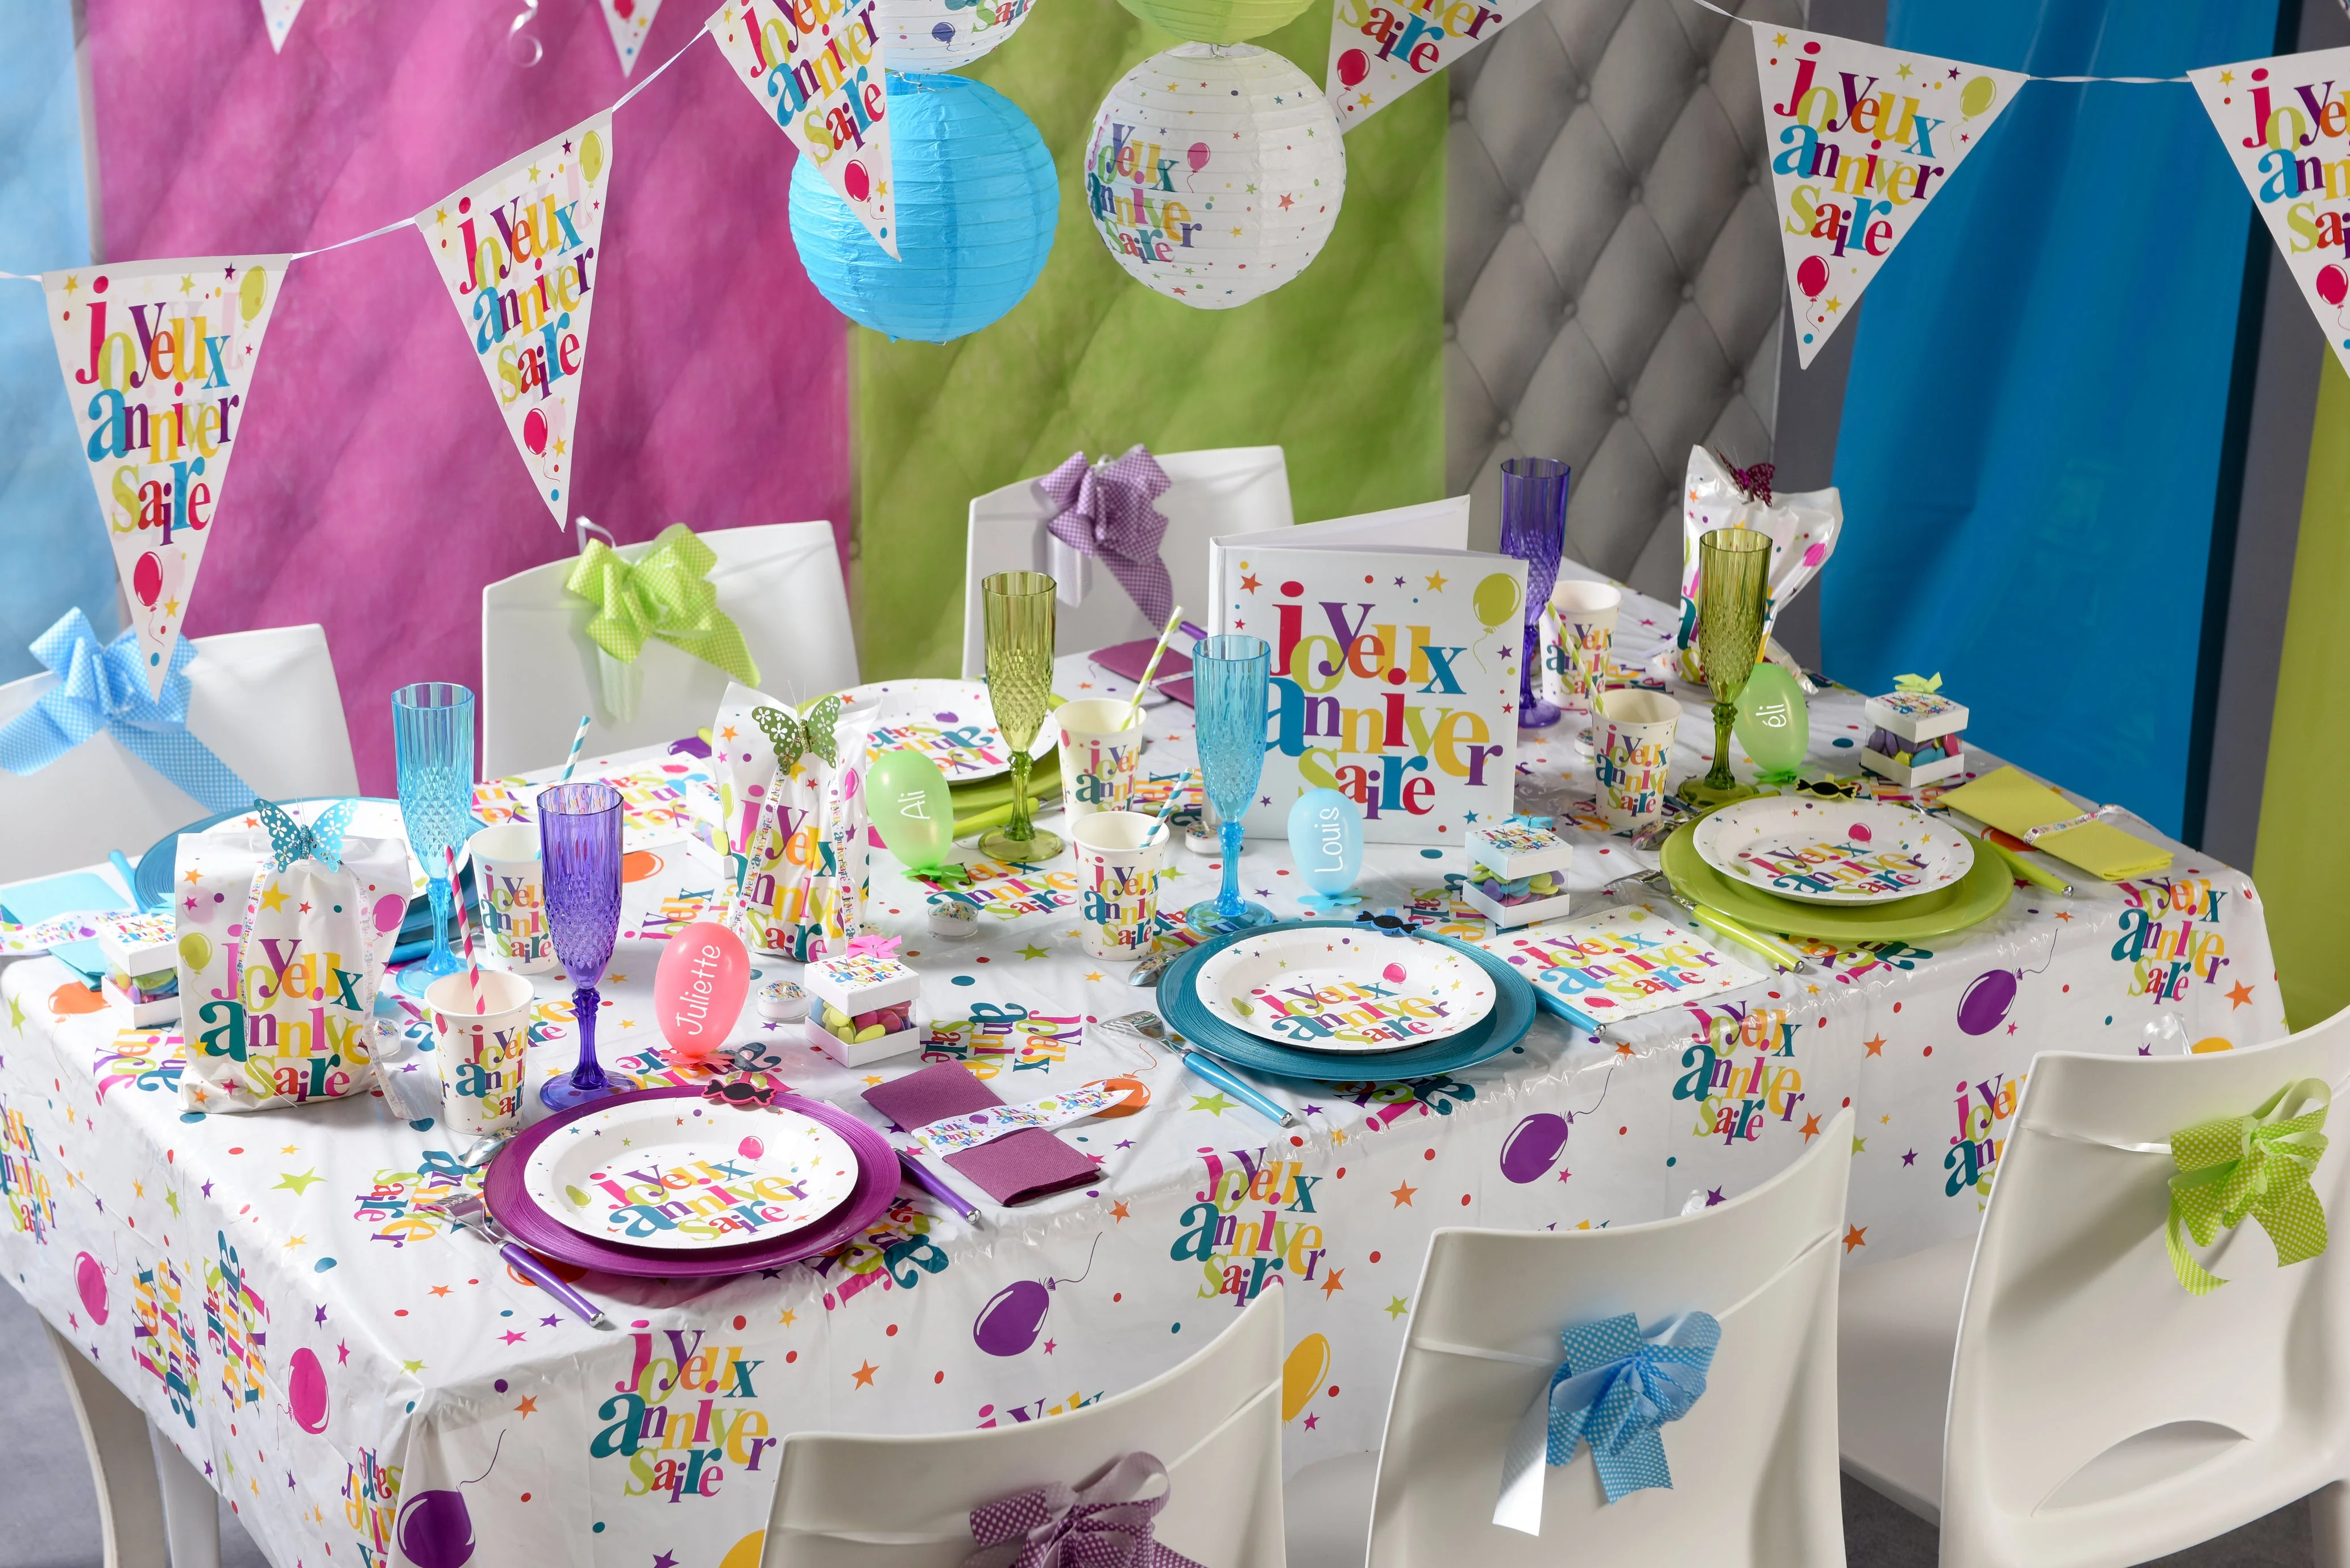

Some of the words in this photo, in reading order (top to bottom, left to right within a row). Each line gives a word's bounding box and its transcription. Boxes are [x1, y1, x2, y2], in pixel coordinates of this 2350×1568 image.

[1773, 41, 1945, 159] joyeux
[1772, 125, 1944, 206] anniver
[457, 193, 584, 295] joyeux
[76, 275, 231, 392] joyeux
[472, 247, 594, 355] anniver
[88, 382, 239, 465] anniver
[1269, 581, 1467, 695] joyeux
[1600, 724, 1669, 768] joyeux
[1314, 806, 1343, 873] Louis
[1738, 842, 1873, 879] joyeux
[1772, 849, 1930, 895] anniver
[1513, 931, 1666, 968] joyeux
[1540, 942, 1724, 995] anniver
[2111, 904, 2229, 984] anniver
[675, 945, 721, 1035] Juliette
[1251, 982, 1401, 1020] joyeux
[1272, 995, 1453, 1042] anniver
[1683, 1001, 1803, 1058] joyeux
[1672, 1039, 1805, 1122] anniver
[589, 1159, 757, 1210] joyeux
[608, 1175, 809, 1238] anniver
[1195, 1147, 1323, 1214] joyeux
[1170, 1192, 1326, 1282] anniver
[615, 1320, 765, 1405] joyeux
[590, 1379, 777, 1471] anniver
